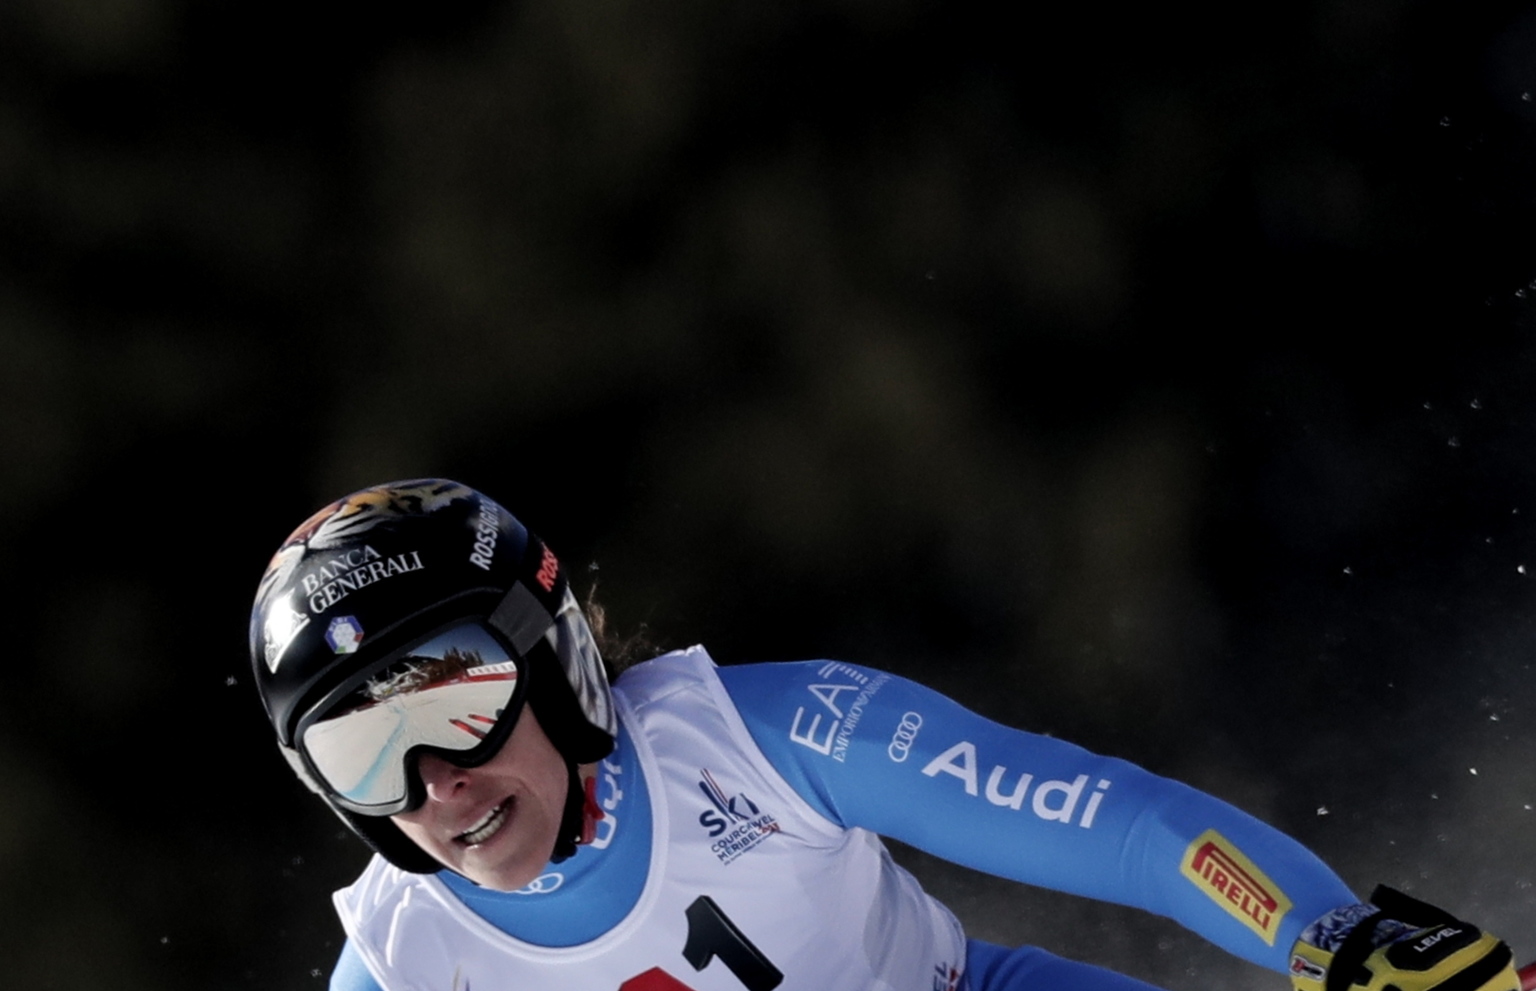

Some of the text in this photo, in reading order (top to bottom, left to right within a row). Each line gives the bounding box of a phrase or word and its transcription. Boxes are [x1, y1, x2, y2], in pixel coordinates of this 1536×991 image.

[302, 545, 381, 597] BANCA
[310, 551, 424, 613] GENERALI
[832, 704, 863, 763] EMPORIO
[921, 741, 1112, 829] Audi
[1191, 841, 1278, 930] PIRELLI
[1413, 927, 1463, 952] LEVEL
